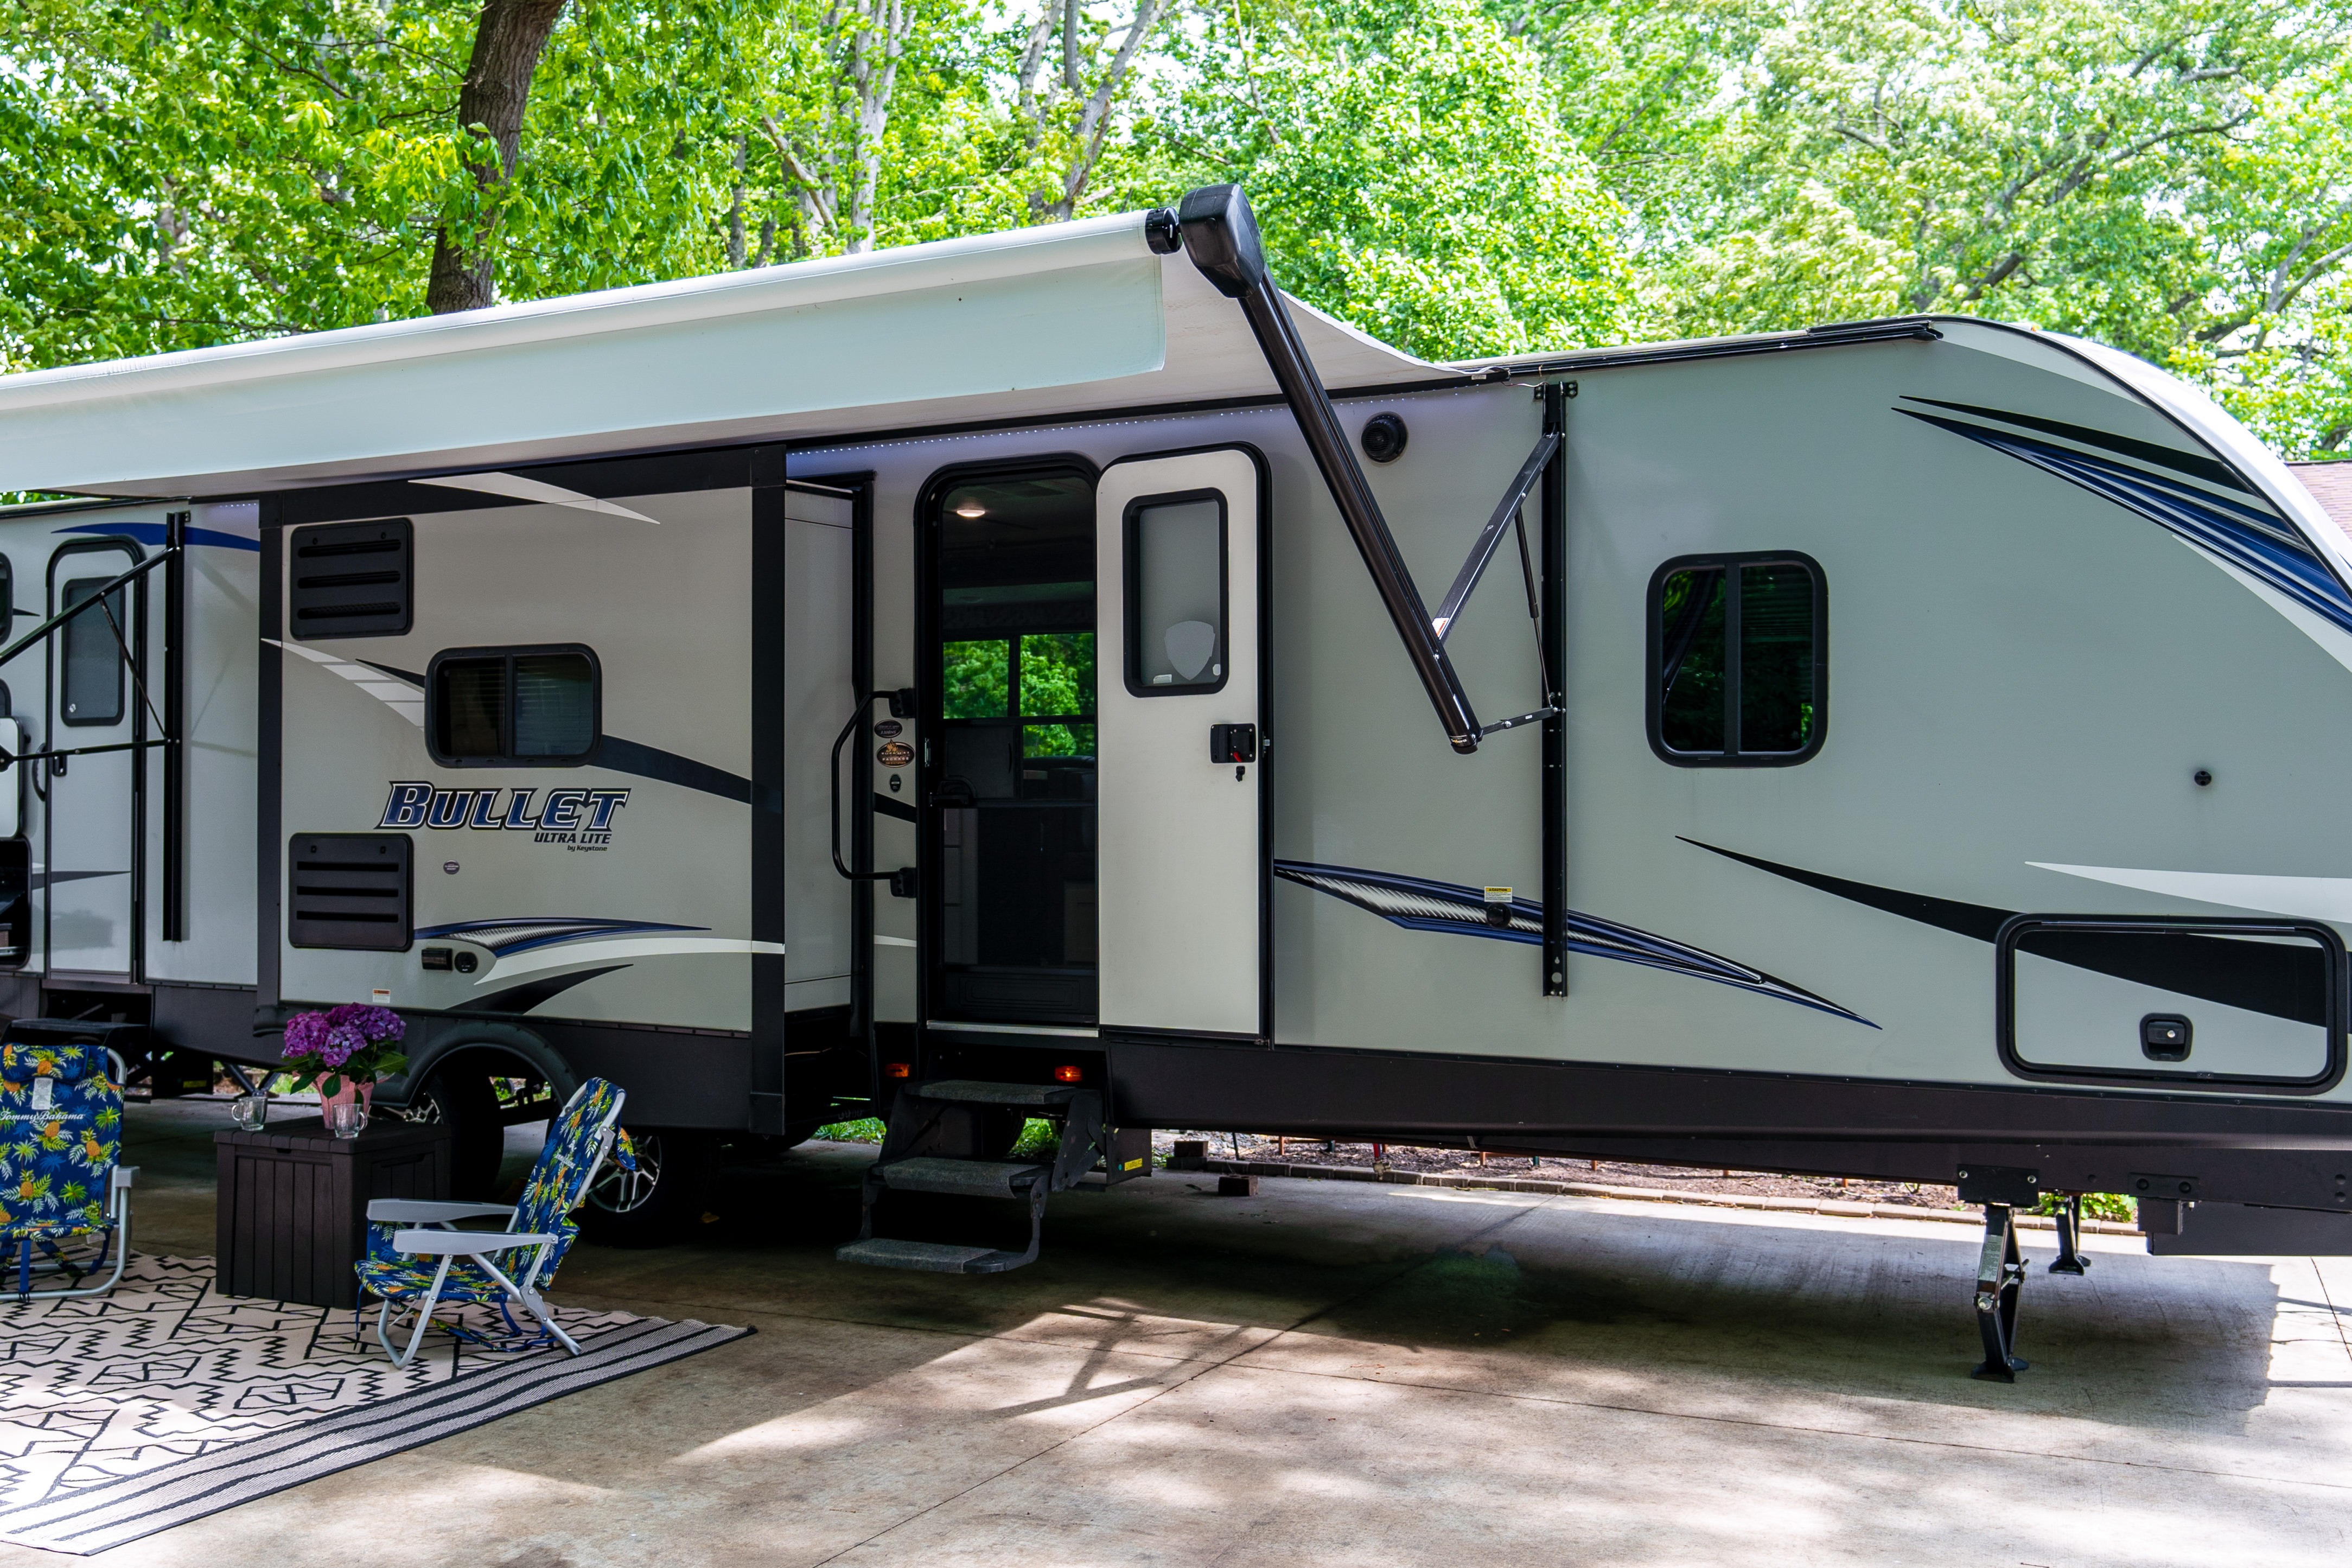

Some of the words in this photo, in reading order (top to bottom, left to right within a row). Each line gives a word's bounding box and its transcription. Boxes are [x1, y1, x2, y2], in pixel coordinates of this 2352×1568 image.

[534, 832, 576, 844] ULTRA
[580, 833, 612, 844] LITE
[0, 1111, 37, 1124] Tommy
[39, 1111, 84, 1120] Bahama
